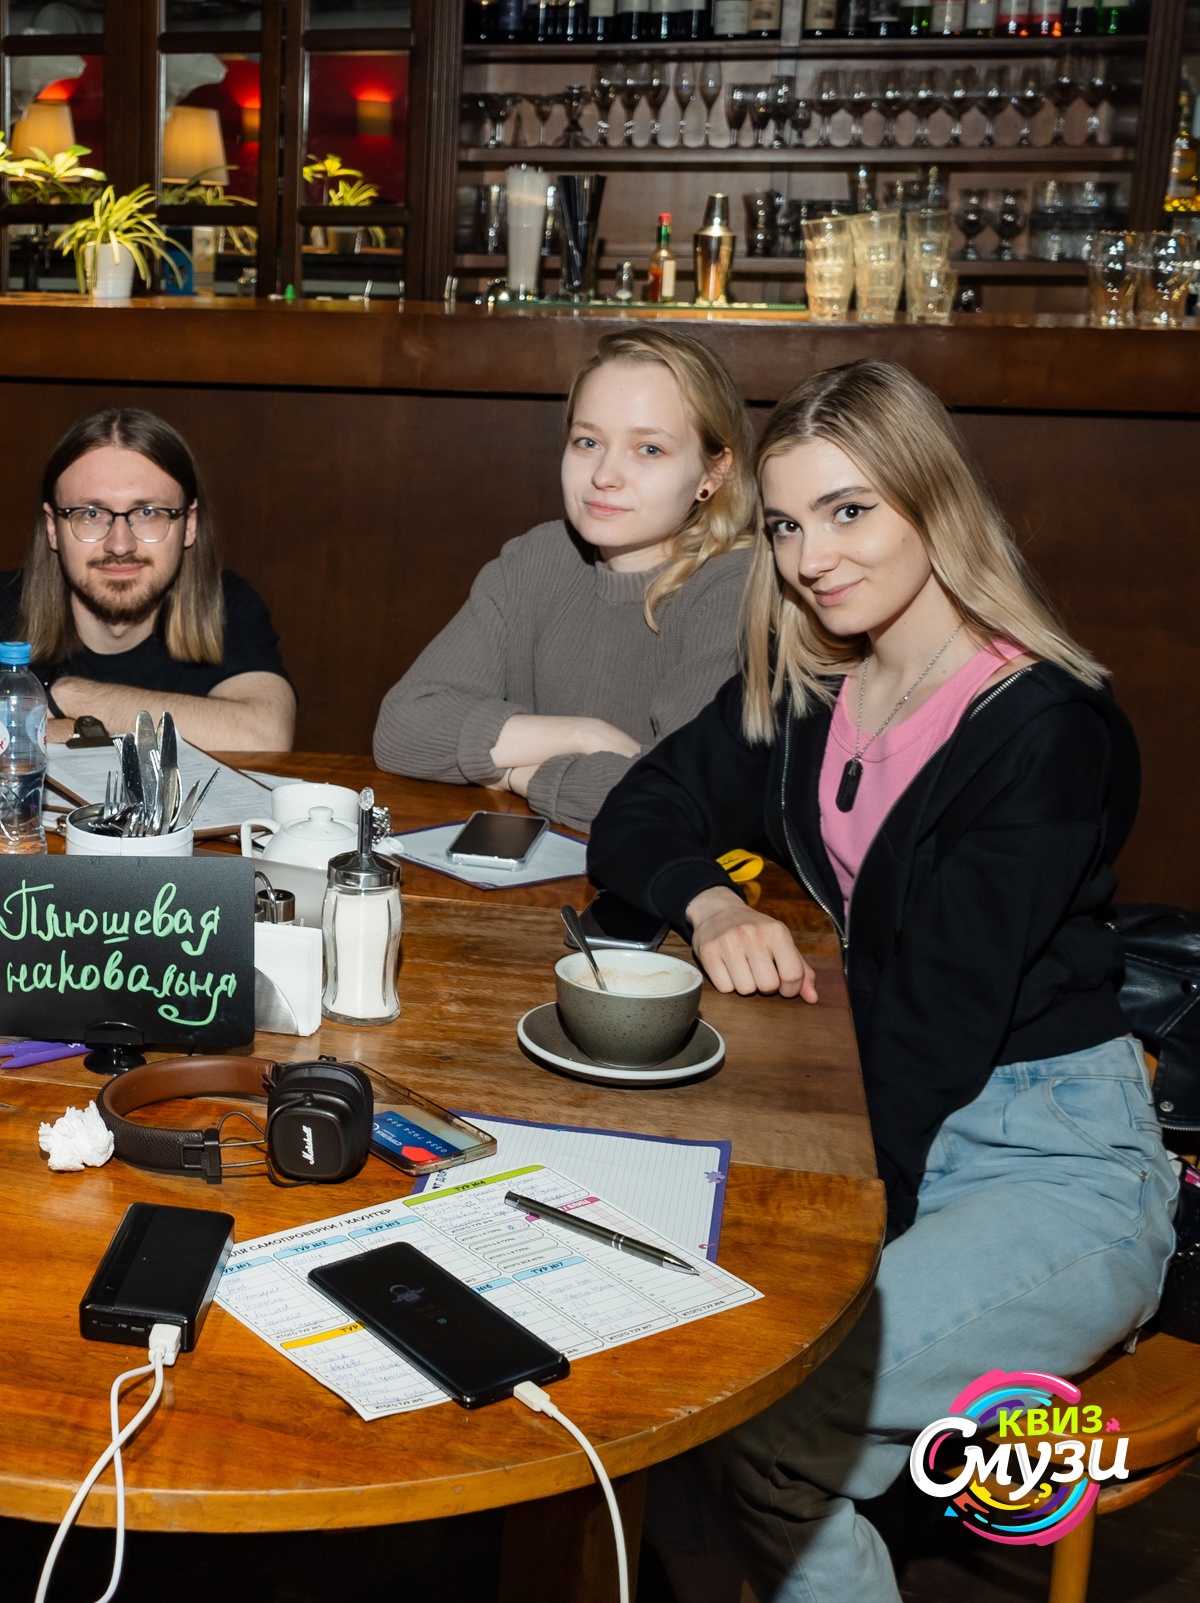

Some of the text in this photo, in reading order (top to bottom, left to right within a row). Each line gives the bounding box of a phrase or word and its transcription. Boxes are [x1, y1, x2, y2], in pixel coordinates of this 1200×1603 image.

[6, 949, 238, 1027] наковальня
[301, 1125, 315, 1165] Marshall
[454, 1184, 471, 1192] ТУР
[249, 1223, 338, 1252] САМОПРОВЕРКИ
[346, 1208, 392, 1226] КАУНТЕР
[366, 1225, 383, 1234] ТУР
[383, 1220, 401, 1229] №3
[294, 1245, 311, 1254] ТУР
[311, 1240, 328, 1249] №2
[530, 1266, 550, 1275] ТУР
[475, 1283, 493, 1293] №6
[340, 1324, 358, 1333] ТУР
